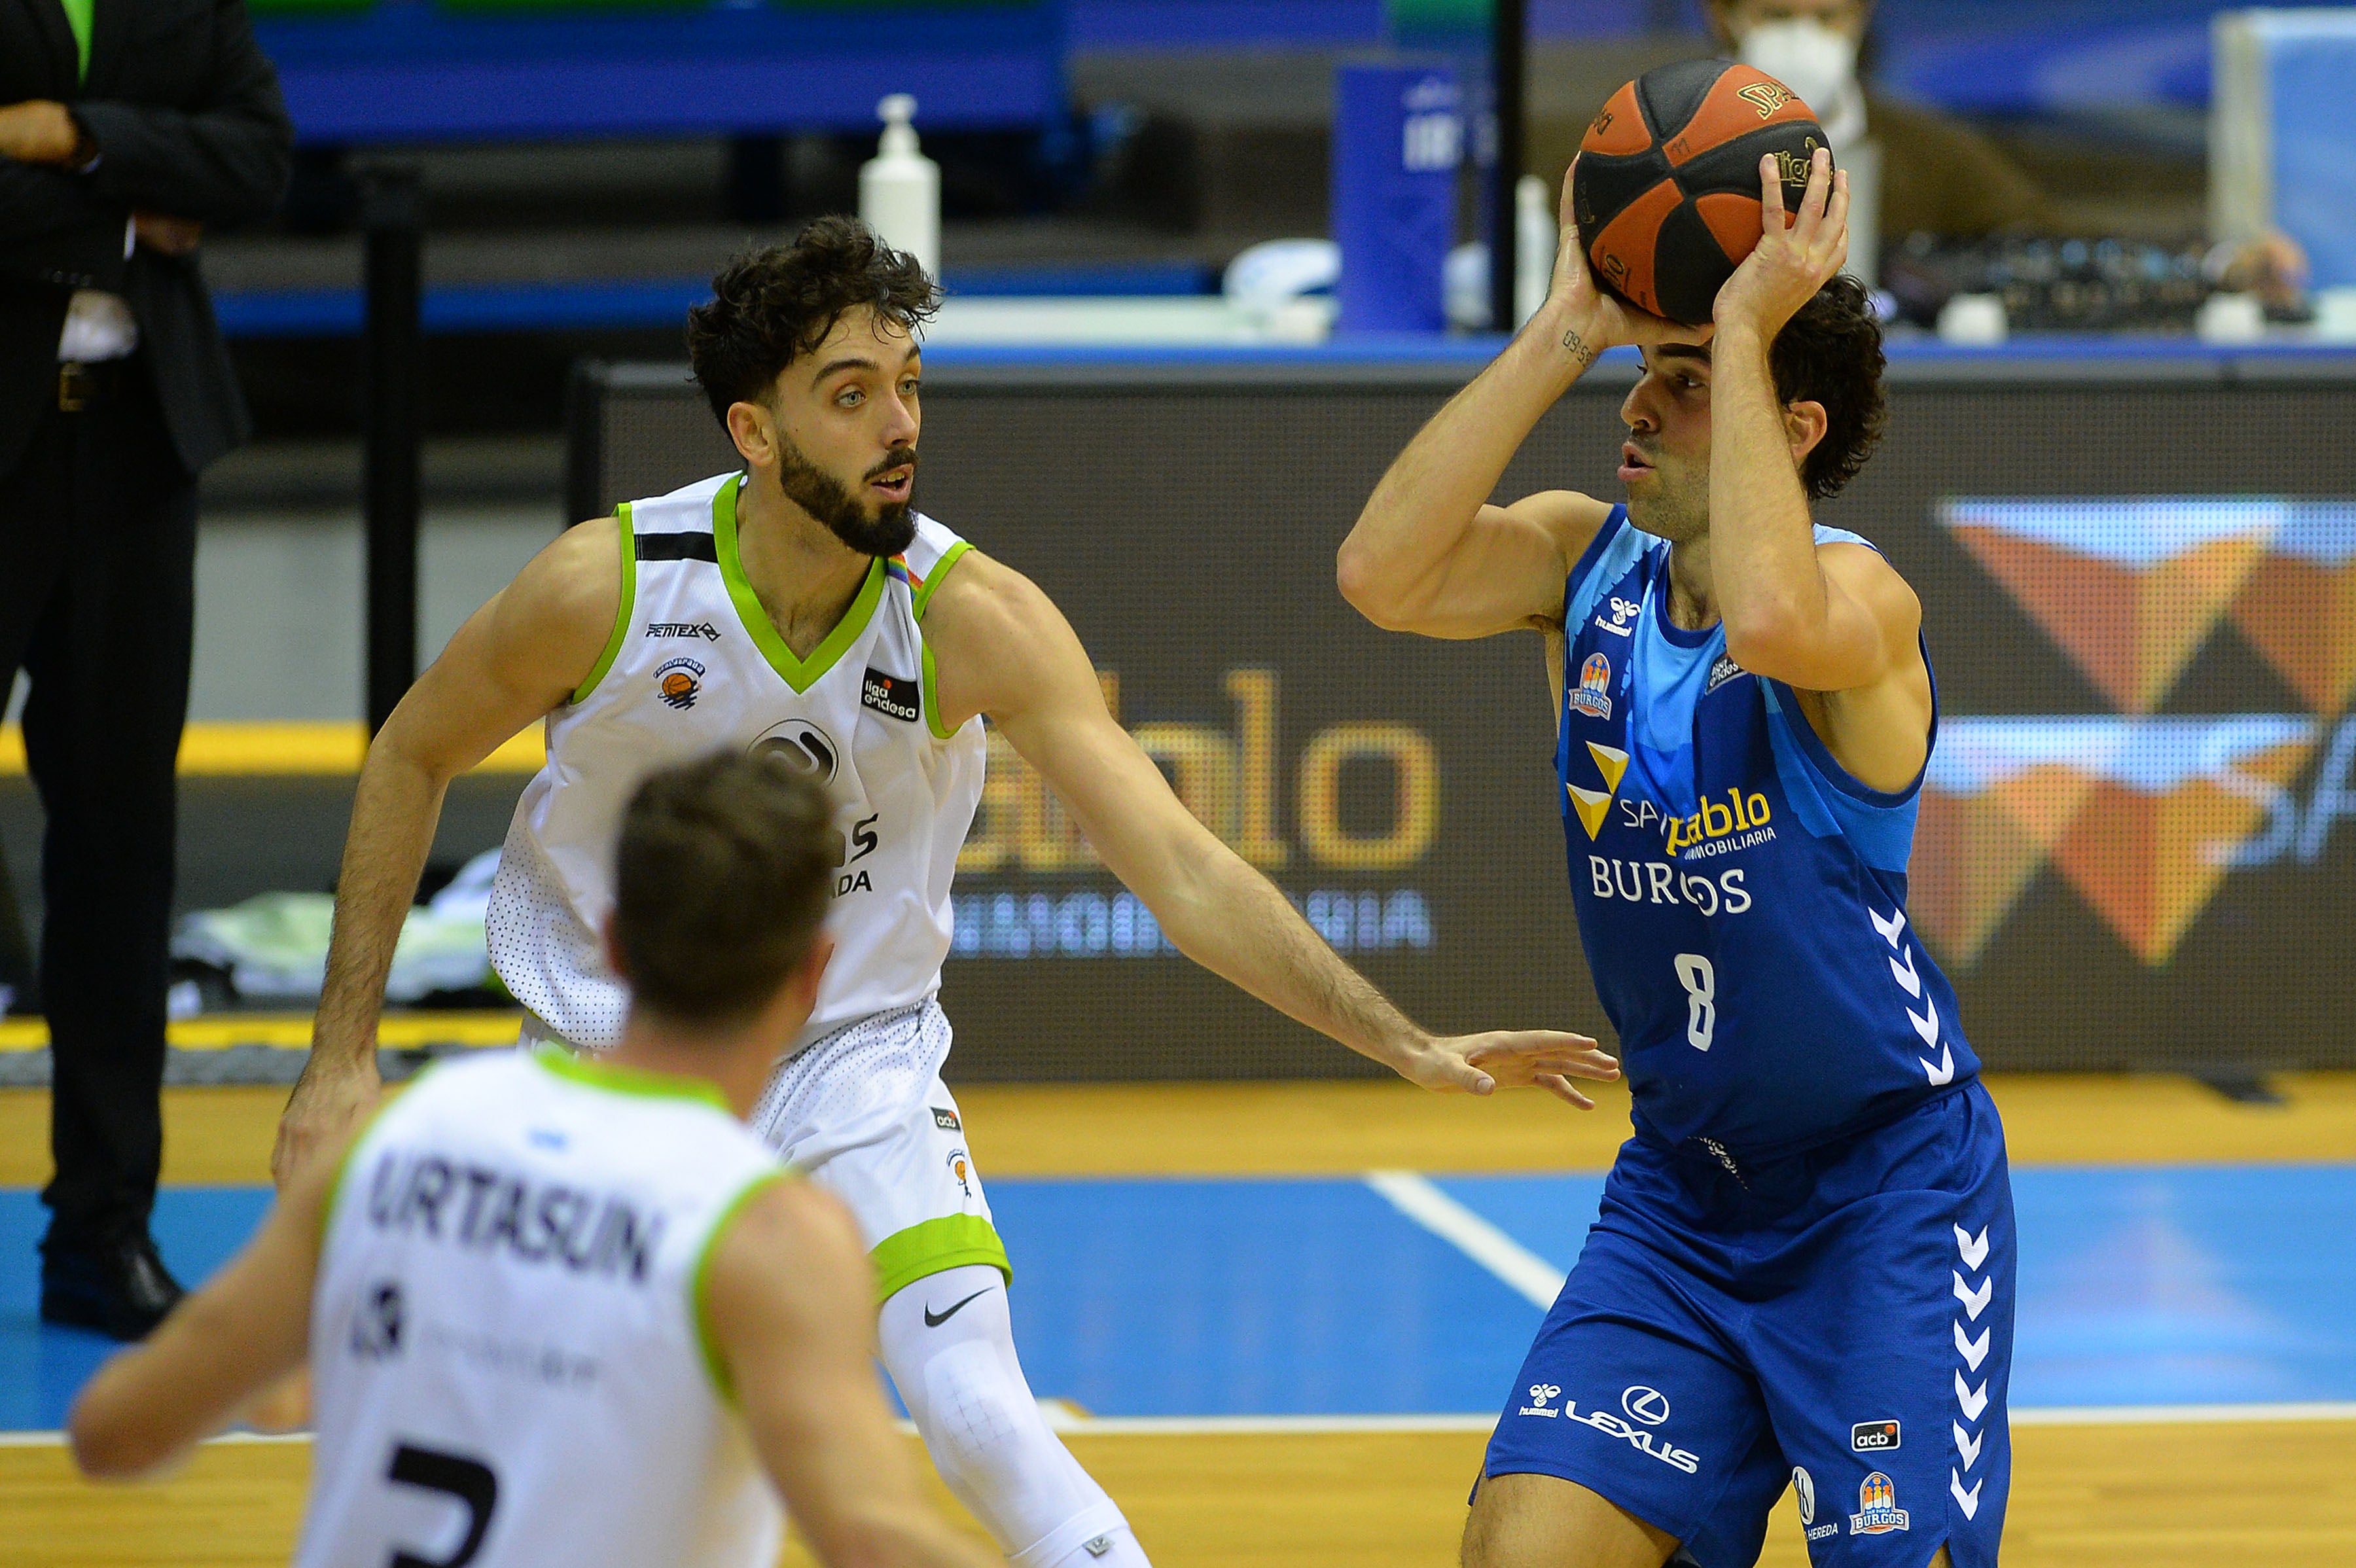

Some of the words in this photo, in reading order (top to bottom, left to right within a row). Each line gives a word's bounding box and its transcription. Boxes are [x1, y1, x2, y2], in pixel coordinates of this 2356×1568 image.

[865, 680, 889, 698] liga
[865, 694, 916, 719] endesa
[1573, 692, 1609, 714] BURGOS
[1673, 953, 1715, 1052] 8
[1518, 1406, 1559, 1418] hummel
[1565, 1400, 1700, 1474] LEXUS
[1856, 1432, 1889, 1447] acb
[1855, 1513, 1904, 1530] BURGOS
[1808, 1522, 1839, 1541] HEREDA
